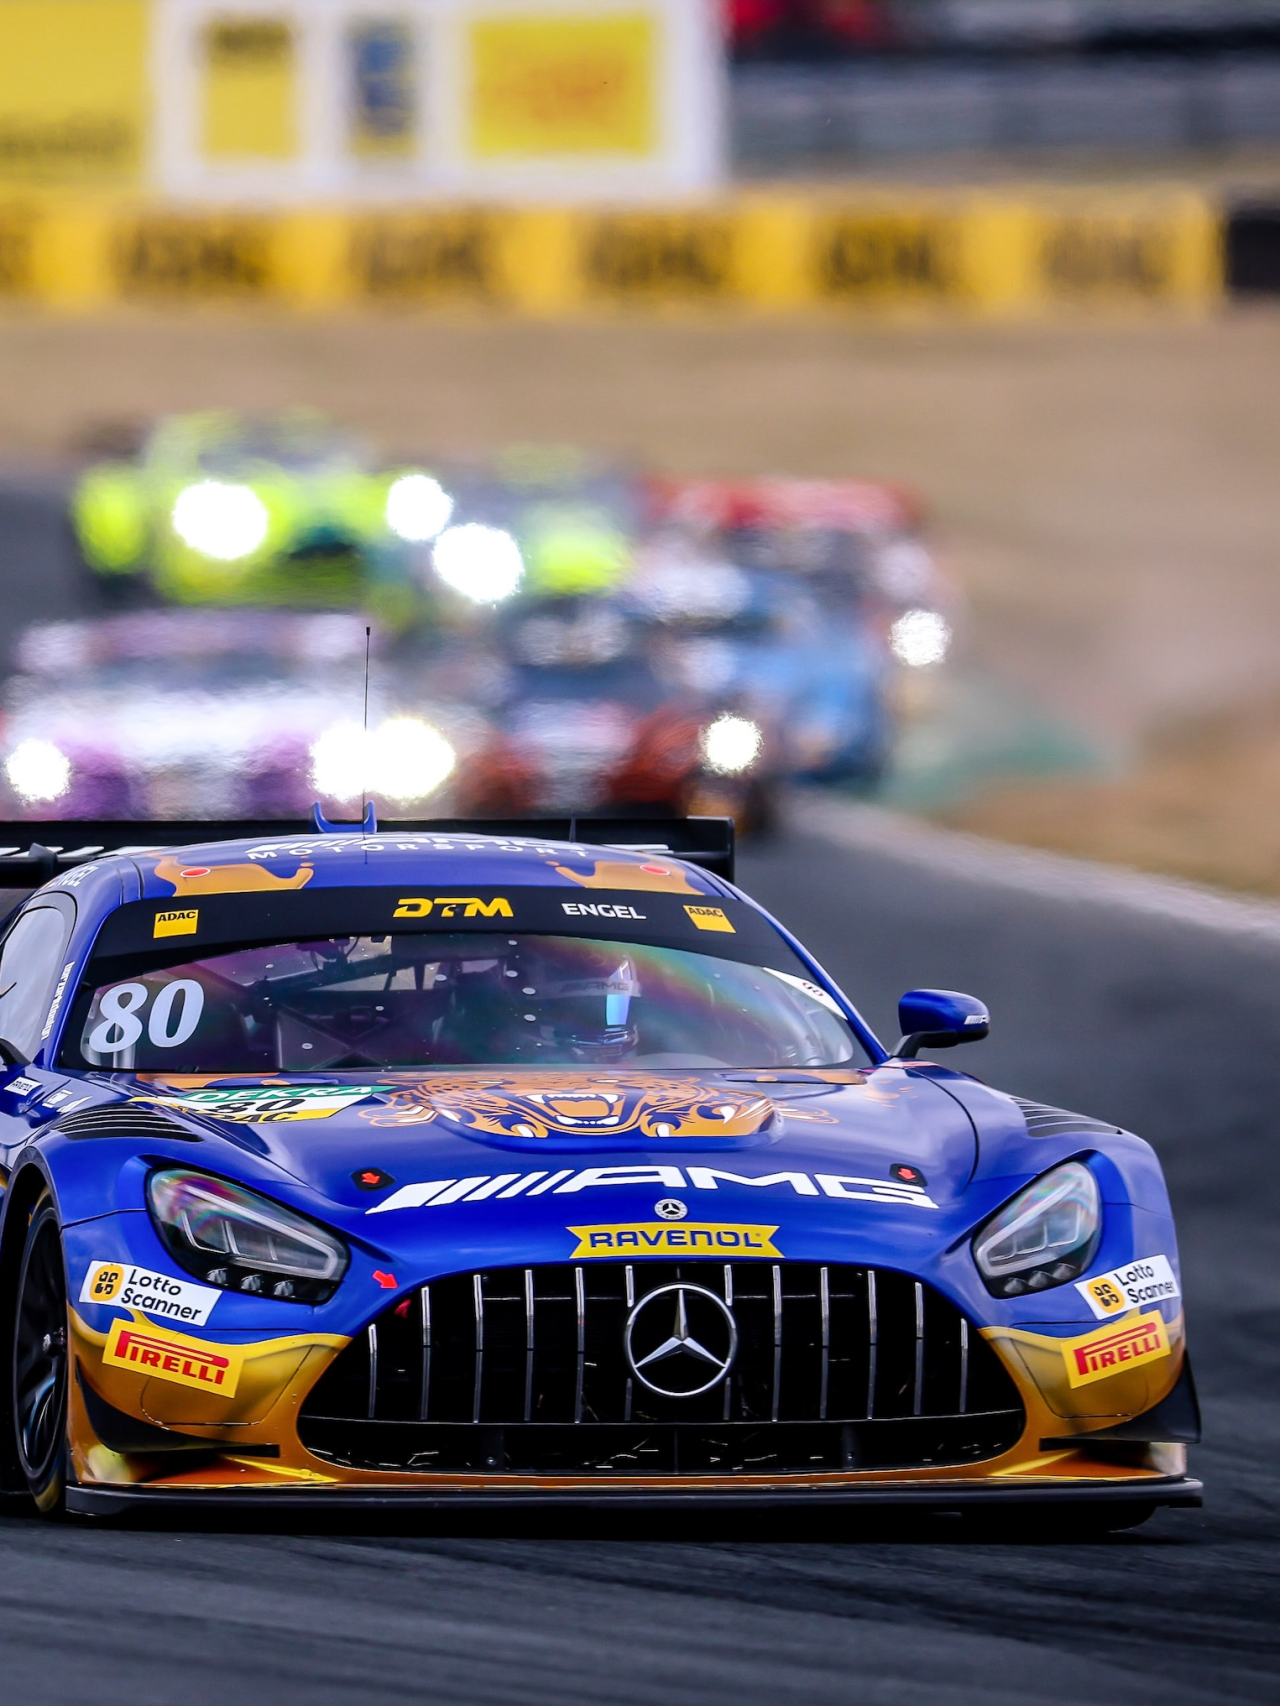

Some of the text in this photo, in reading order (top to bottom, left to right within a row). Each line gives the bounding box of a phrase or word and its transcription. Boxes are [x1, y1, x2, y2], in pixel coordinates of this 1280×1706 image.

[246, 843, 589, 860] MOTORSPORT
[157, 910, 197, 923] ADAC
[393, 897, 514, 918] DTM
[561, 902, 646, 919] ENGEL
[687, 906, 724, 919] ADAC
[89, 979, 204, 1053] 80
[187, 1086, 372, 1102] DEKRA
[208, 1098, 306, 1114] 80
[553, 1164, 939, 1209] AMG
[589, 1229, 763, 1249] RAVENOL
[127, 1269, 182, 1297] Lotto
[1113, 1264, 1155, 1287] Lotto
[1126, 1281, 1176, 1304] Scanner
[120, 1287, 203, 1321] Scanner
[114, 1329, 230, 1385] PIRELLI
[1072, 1321, 1163, 1376] PIRELLI
